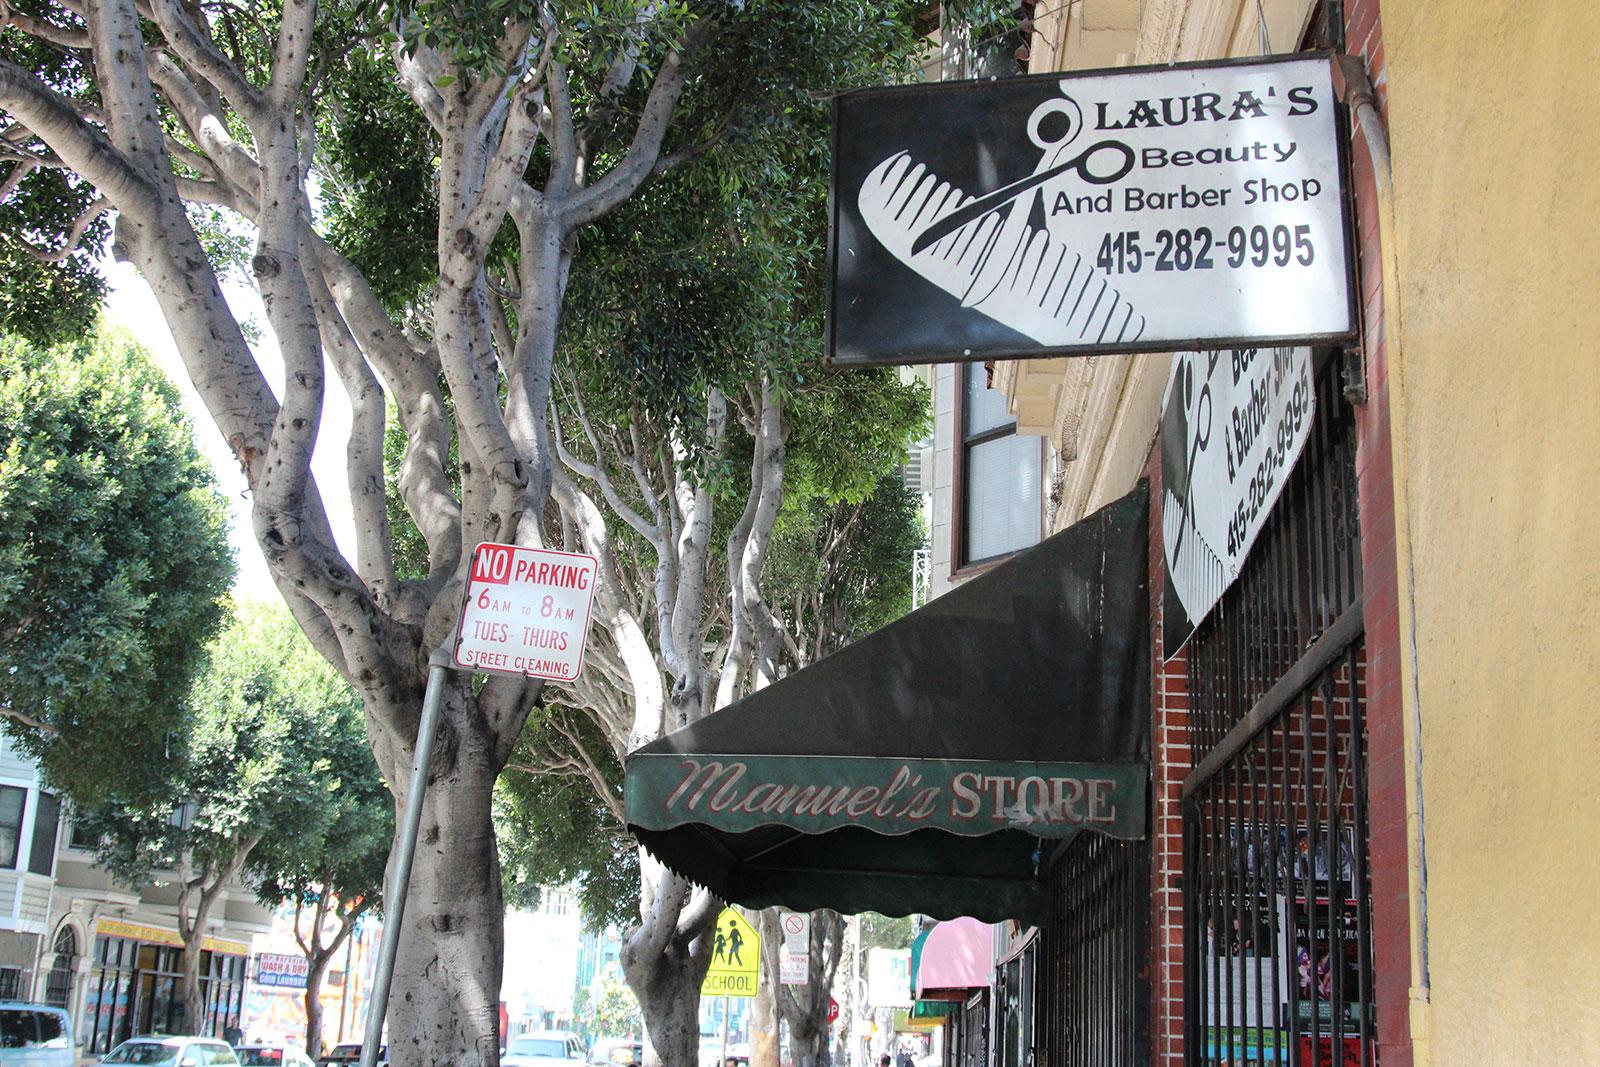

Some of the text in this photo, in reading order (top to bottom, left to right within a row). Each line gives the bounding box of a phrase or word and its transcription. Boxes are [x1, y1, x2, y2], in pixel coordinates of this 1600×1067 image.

[1093, 86, 1319, 130] LAURA'S
[1141, 140, 1297, 169] Beauty
[1051, 177, 1322, 216] And Barber Shop
[1096, 224, 1315, 276] 415-282-9995
[1231, 364, 1271, 468] Barber
[1226, 357, 1309, 558] 415-282-9995
[475, 548, 590, 591] NO PARKING
[474, 620, 569, 651] TUES THURS
[466, 650, 570, 675] STREET CLEANING
[664, 759, 1117, 825] Manuel's STORE
[259, 974, 307, 987] COIN LAUNDRY
[261, 961, 283, 973] WASH
[292, 964, 307, 975] DRY
[704, 975, 753, 991] SCHOOL
